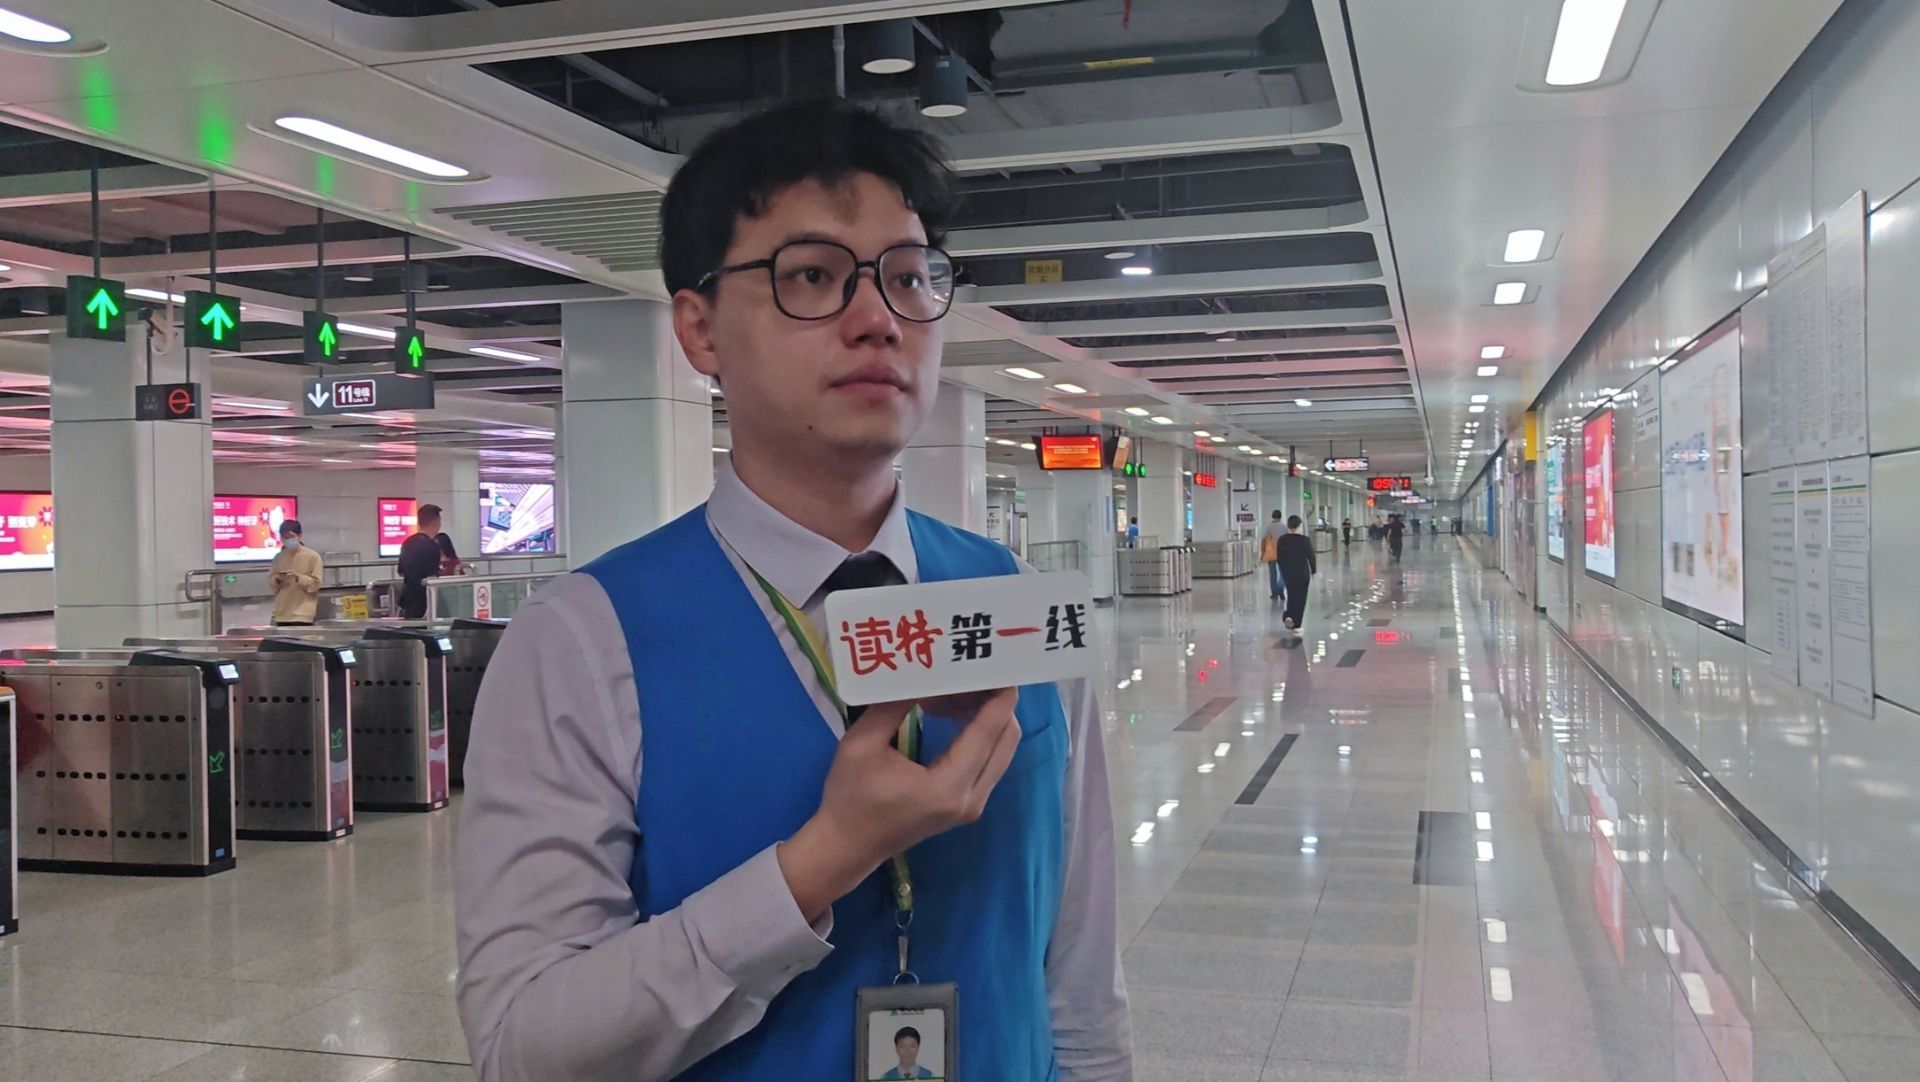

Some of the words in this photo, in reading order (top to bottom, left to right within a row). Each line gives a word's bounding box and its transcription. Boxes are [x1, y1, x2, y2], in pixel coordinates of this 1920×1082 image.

[840, 603, 1087, 676] 读特第一线
